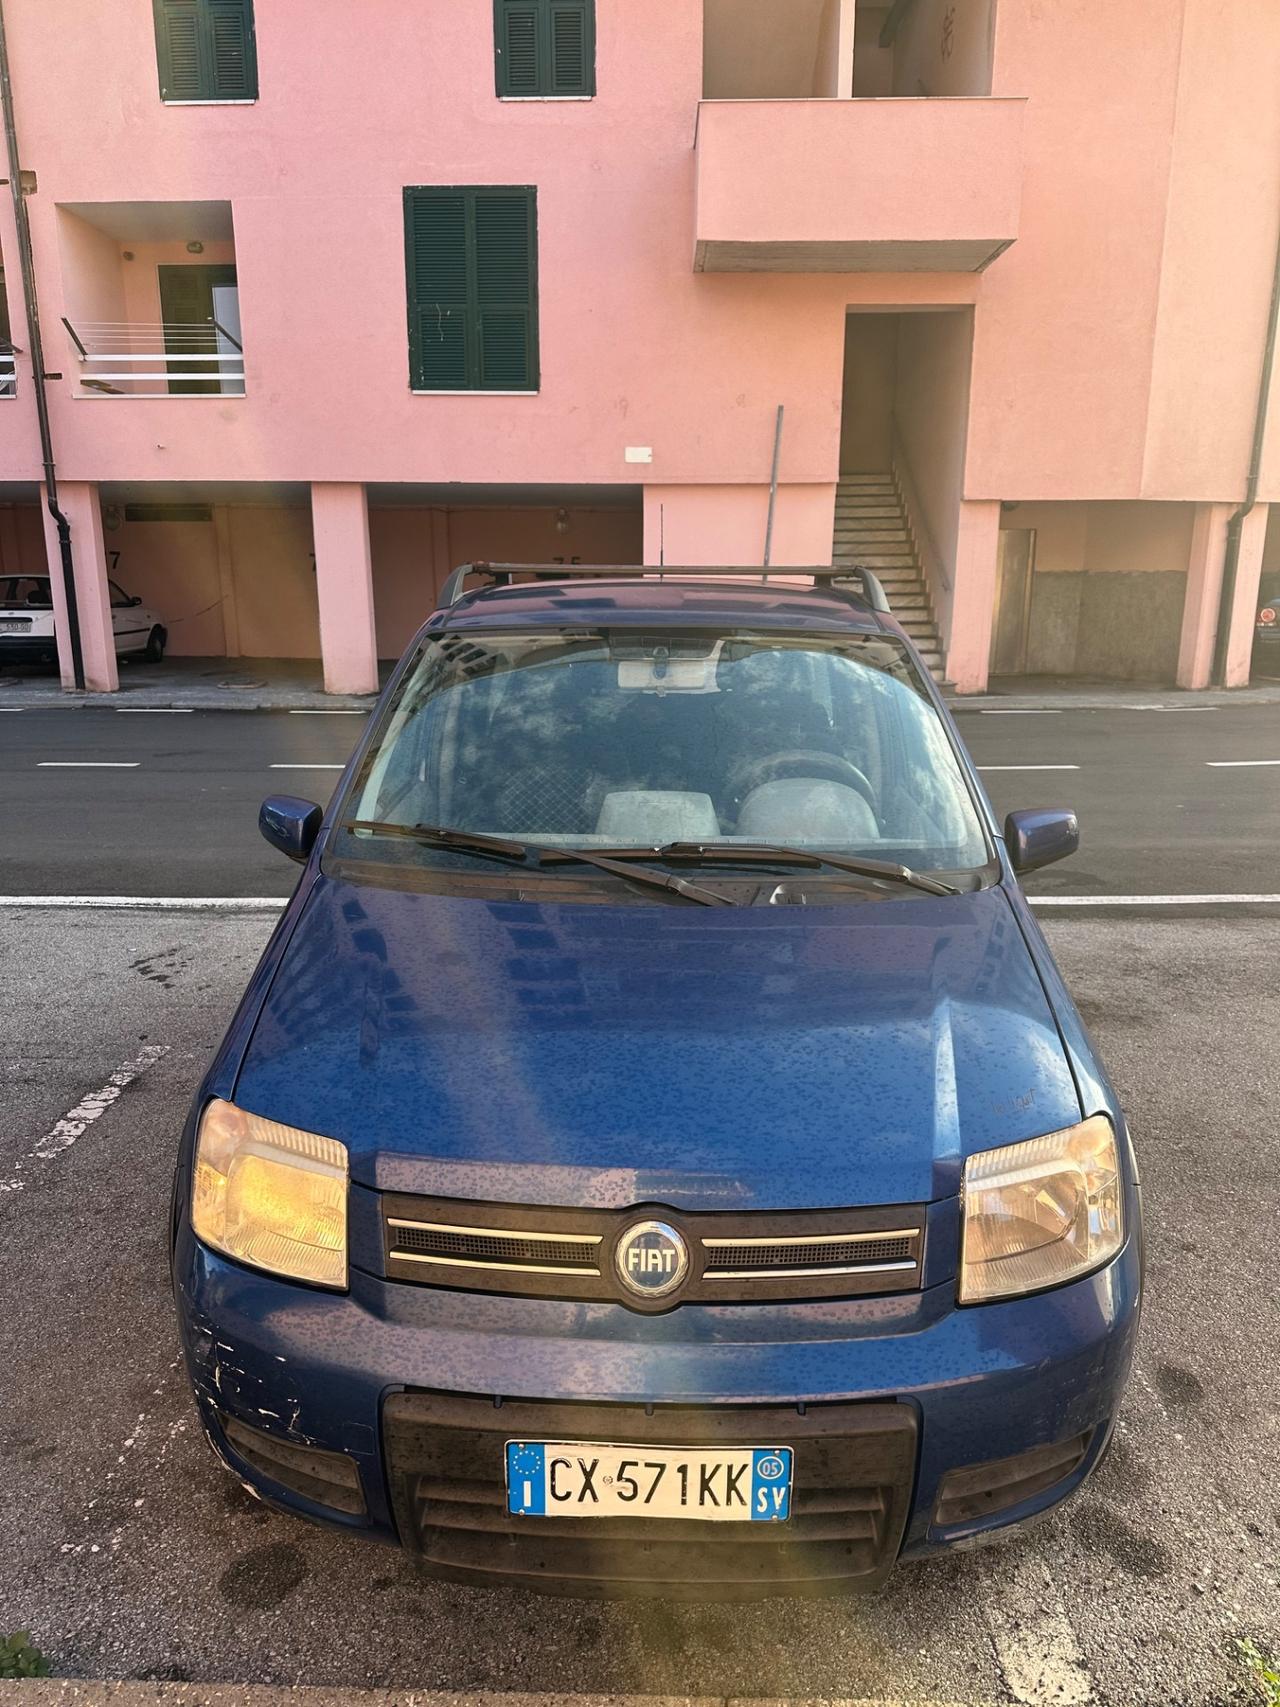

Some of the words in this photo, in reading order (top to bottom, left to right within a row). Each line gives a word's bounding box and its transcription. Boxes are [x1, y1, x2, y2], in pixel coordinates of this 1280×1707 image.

[628, 1247, 676, 1273] FIAT
[549, 1457, 600, 1503] CX
[616, 1460, 749, 1507] 571KK
[762, 1462, 778, 1476] 05
[756, 1486, 787, 1513] SV
